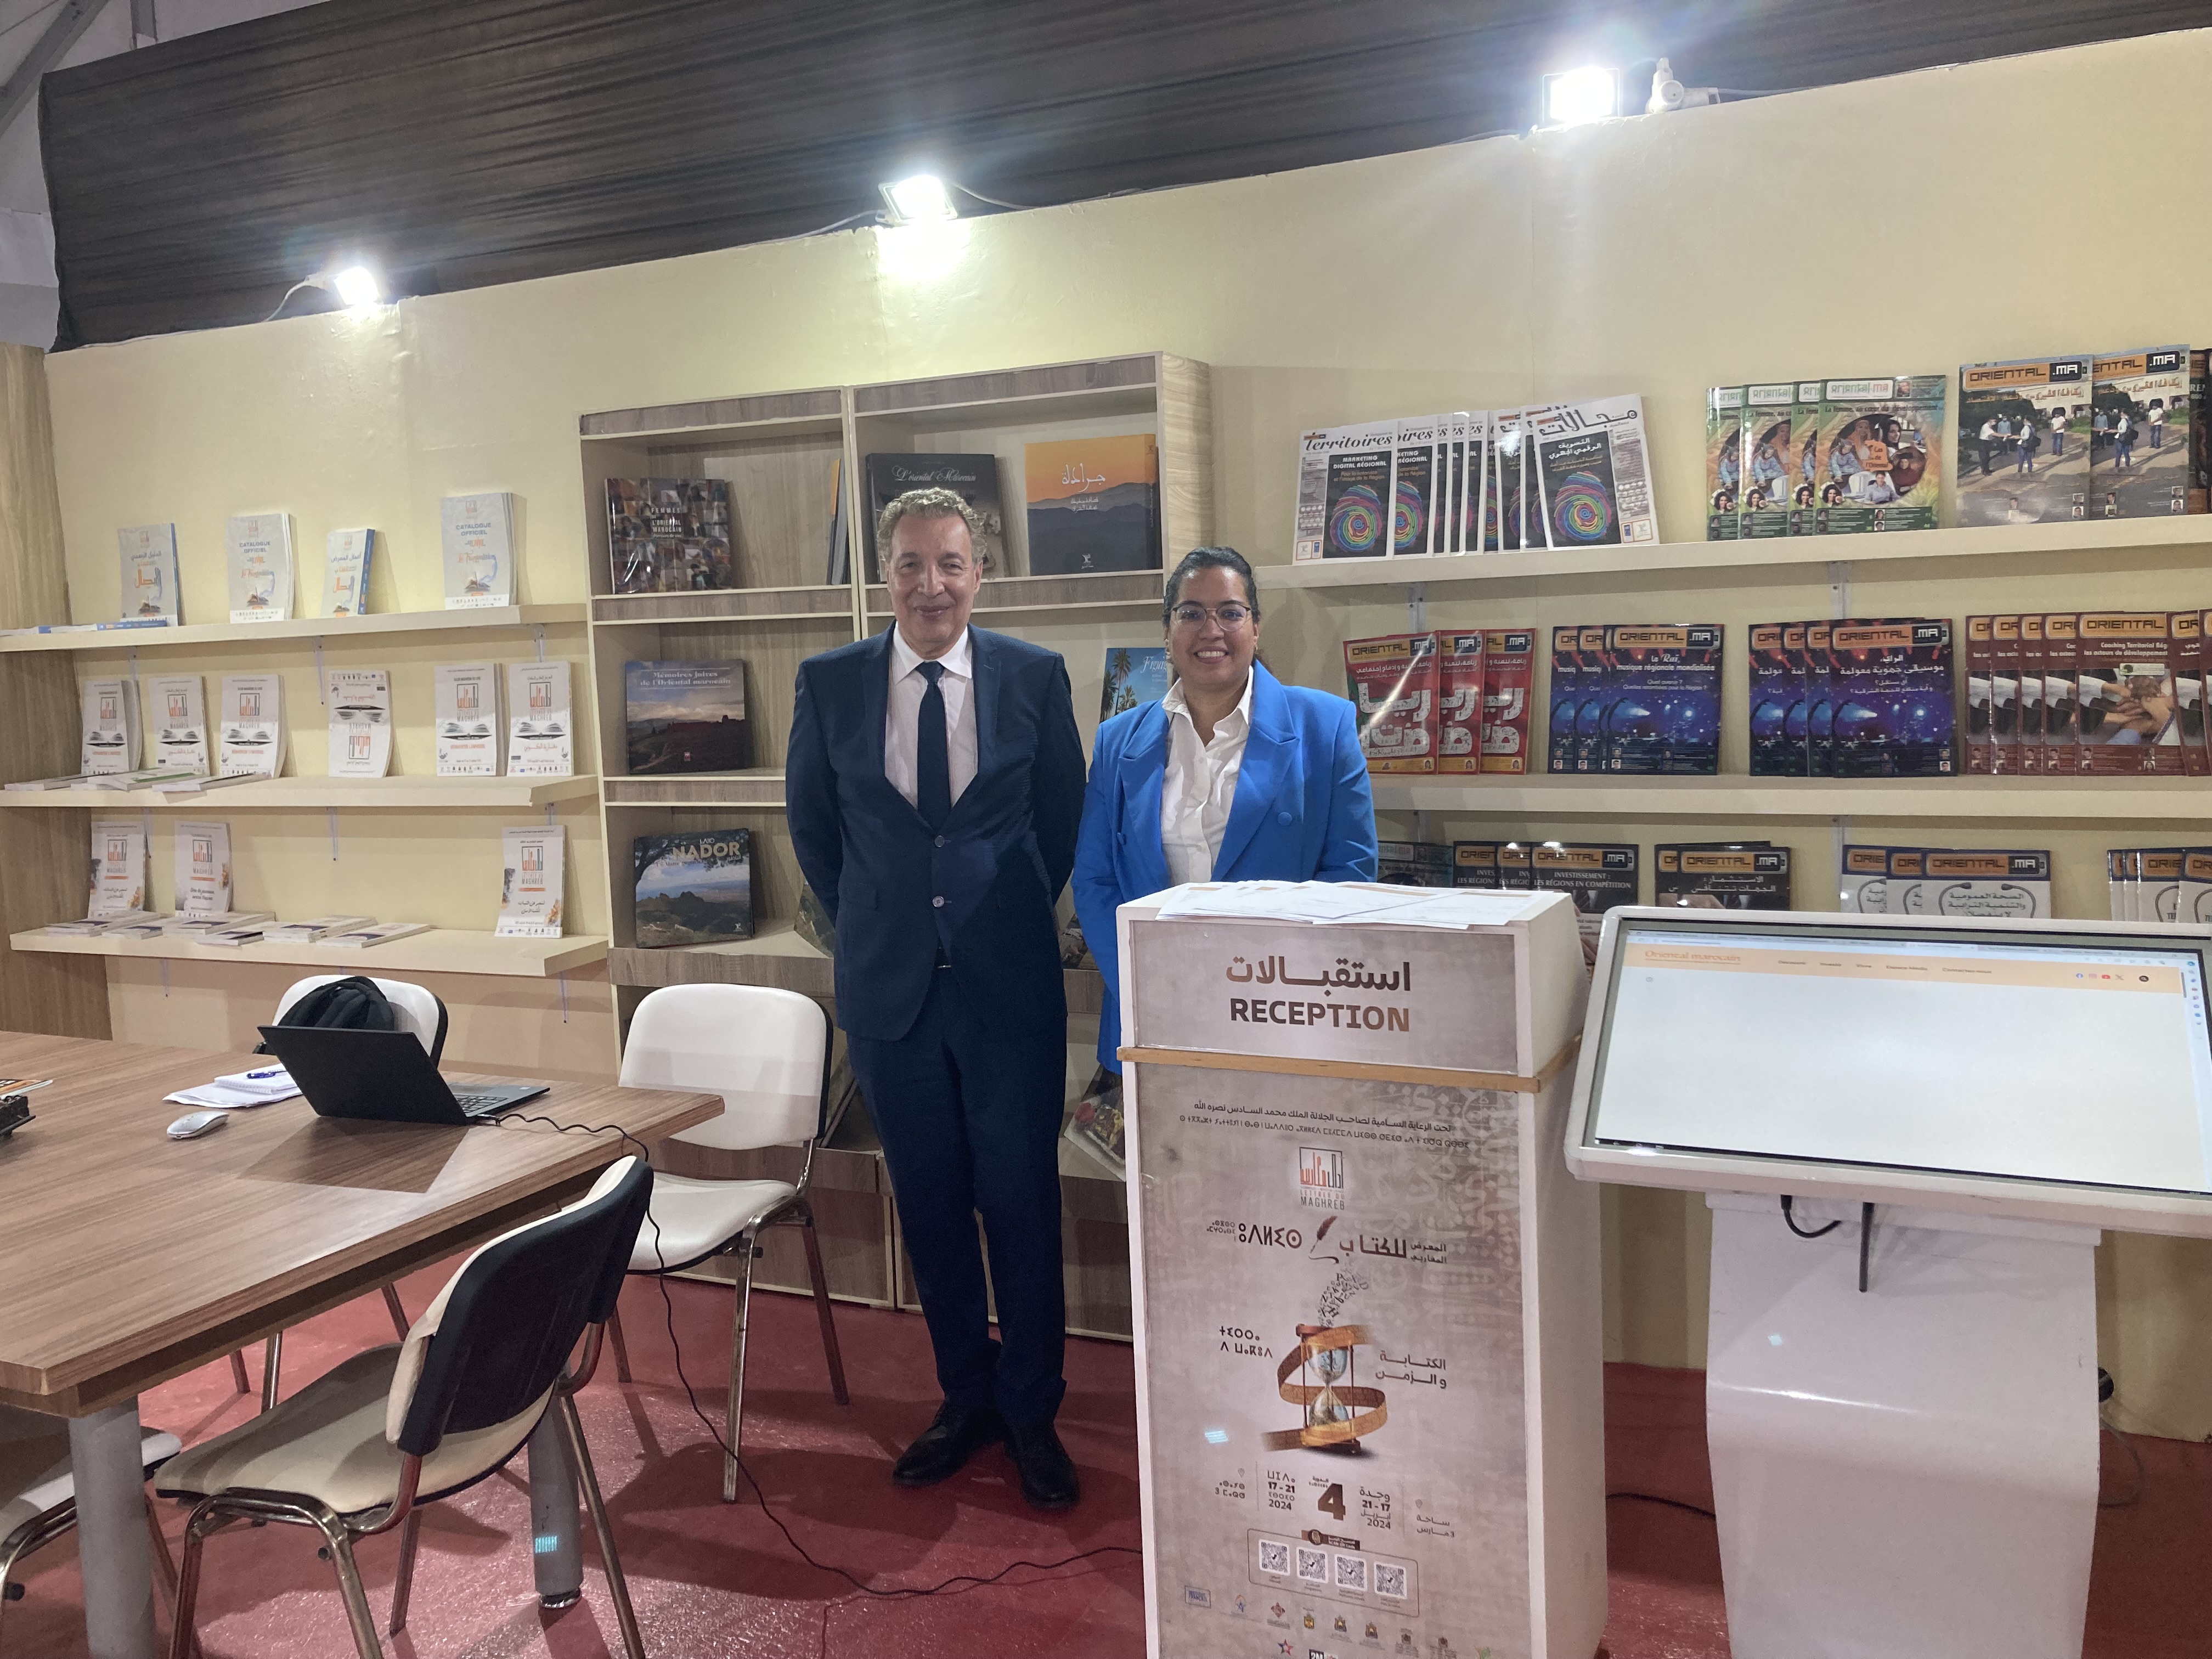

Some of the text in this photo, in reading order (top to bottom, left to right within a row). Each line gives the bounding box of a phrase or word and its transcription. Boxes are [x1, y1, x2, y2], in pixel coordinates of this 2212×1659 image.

[1970, 368, 2046, 382] ORIENTAL
[1539, 409, 1637, 436] مجالات
[2087, 620, 2164, 629] ORIENTAL
[1620, 632, 1684, 641] ORIENTAL
[1839, 630, 1909, 641] ORIENTAL
[1352, 644, 1408, 656] ORIENTAL
[1840, 664, 1944, 676] موسيقى جهوية معولمة
[673, 842, 740, 860] NADOR
[1538, 852, 1600, 861] ORIENTAL
[1686, 856, 1751, 866] ORIENTAL
[1933, 858, 2005, 868] ORIENTAL
[1545, 879, 1574, 887] RÉGIONS
[1645, 950, 1690, 958] Oriental
[1226, 956, 1410, 996] استقبالات
[1230, 997, 1409, 1032] RECEPTION
[1194, 1101, 1206, 1110] الله
[1207, 1103, 1226, 1113] نصره
[1227, 1107, 1262, 1116] السادس
[1264, 1109, 1286, 1118] محمد
[1288, 1110, 1308, 1119] الملك
[1310, 1112, 1334, 1122] الجلالة
[1336, 1116, 1370, 1125] لصاحب
[1372, 1117, 1406, 1128] السامية
[1408, 1121, 1432, 1132] الرعاية
[1301, 1197, 1345, 1210] MAGHREB
[1340, 1234, 1407, 1258] للكتاب
[1410, 1242, 1446, 1252] المعرض
[1380, 1351, 1446, 1370] الكتابة
[1268, 1482, 1295, 1493] 17 21
[1359, 1486, 1390, 1502] وجدة
[1269, 1499, 1292, 1510] 2024
[1318, 1482, 1346, 1521] 4
[1362, 1500, 1391, 1511] 21 17
[1367, 1518, 1391, 1530] 2024
